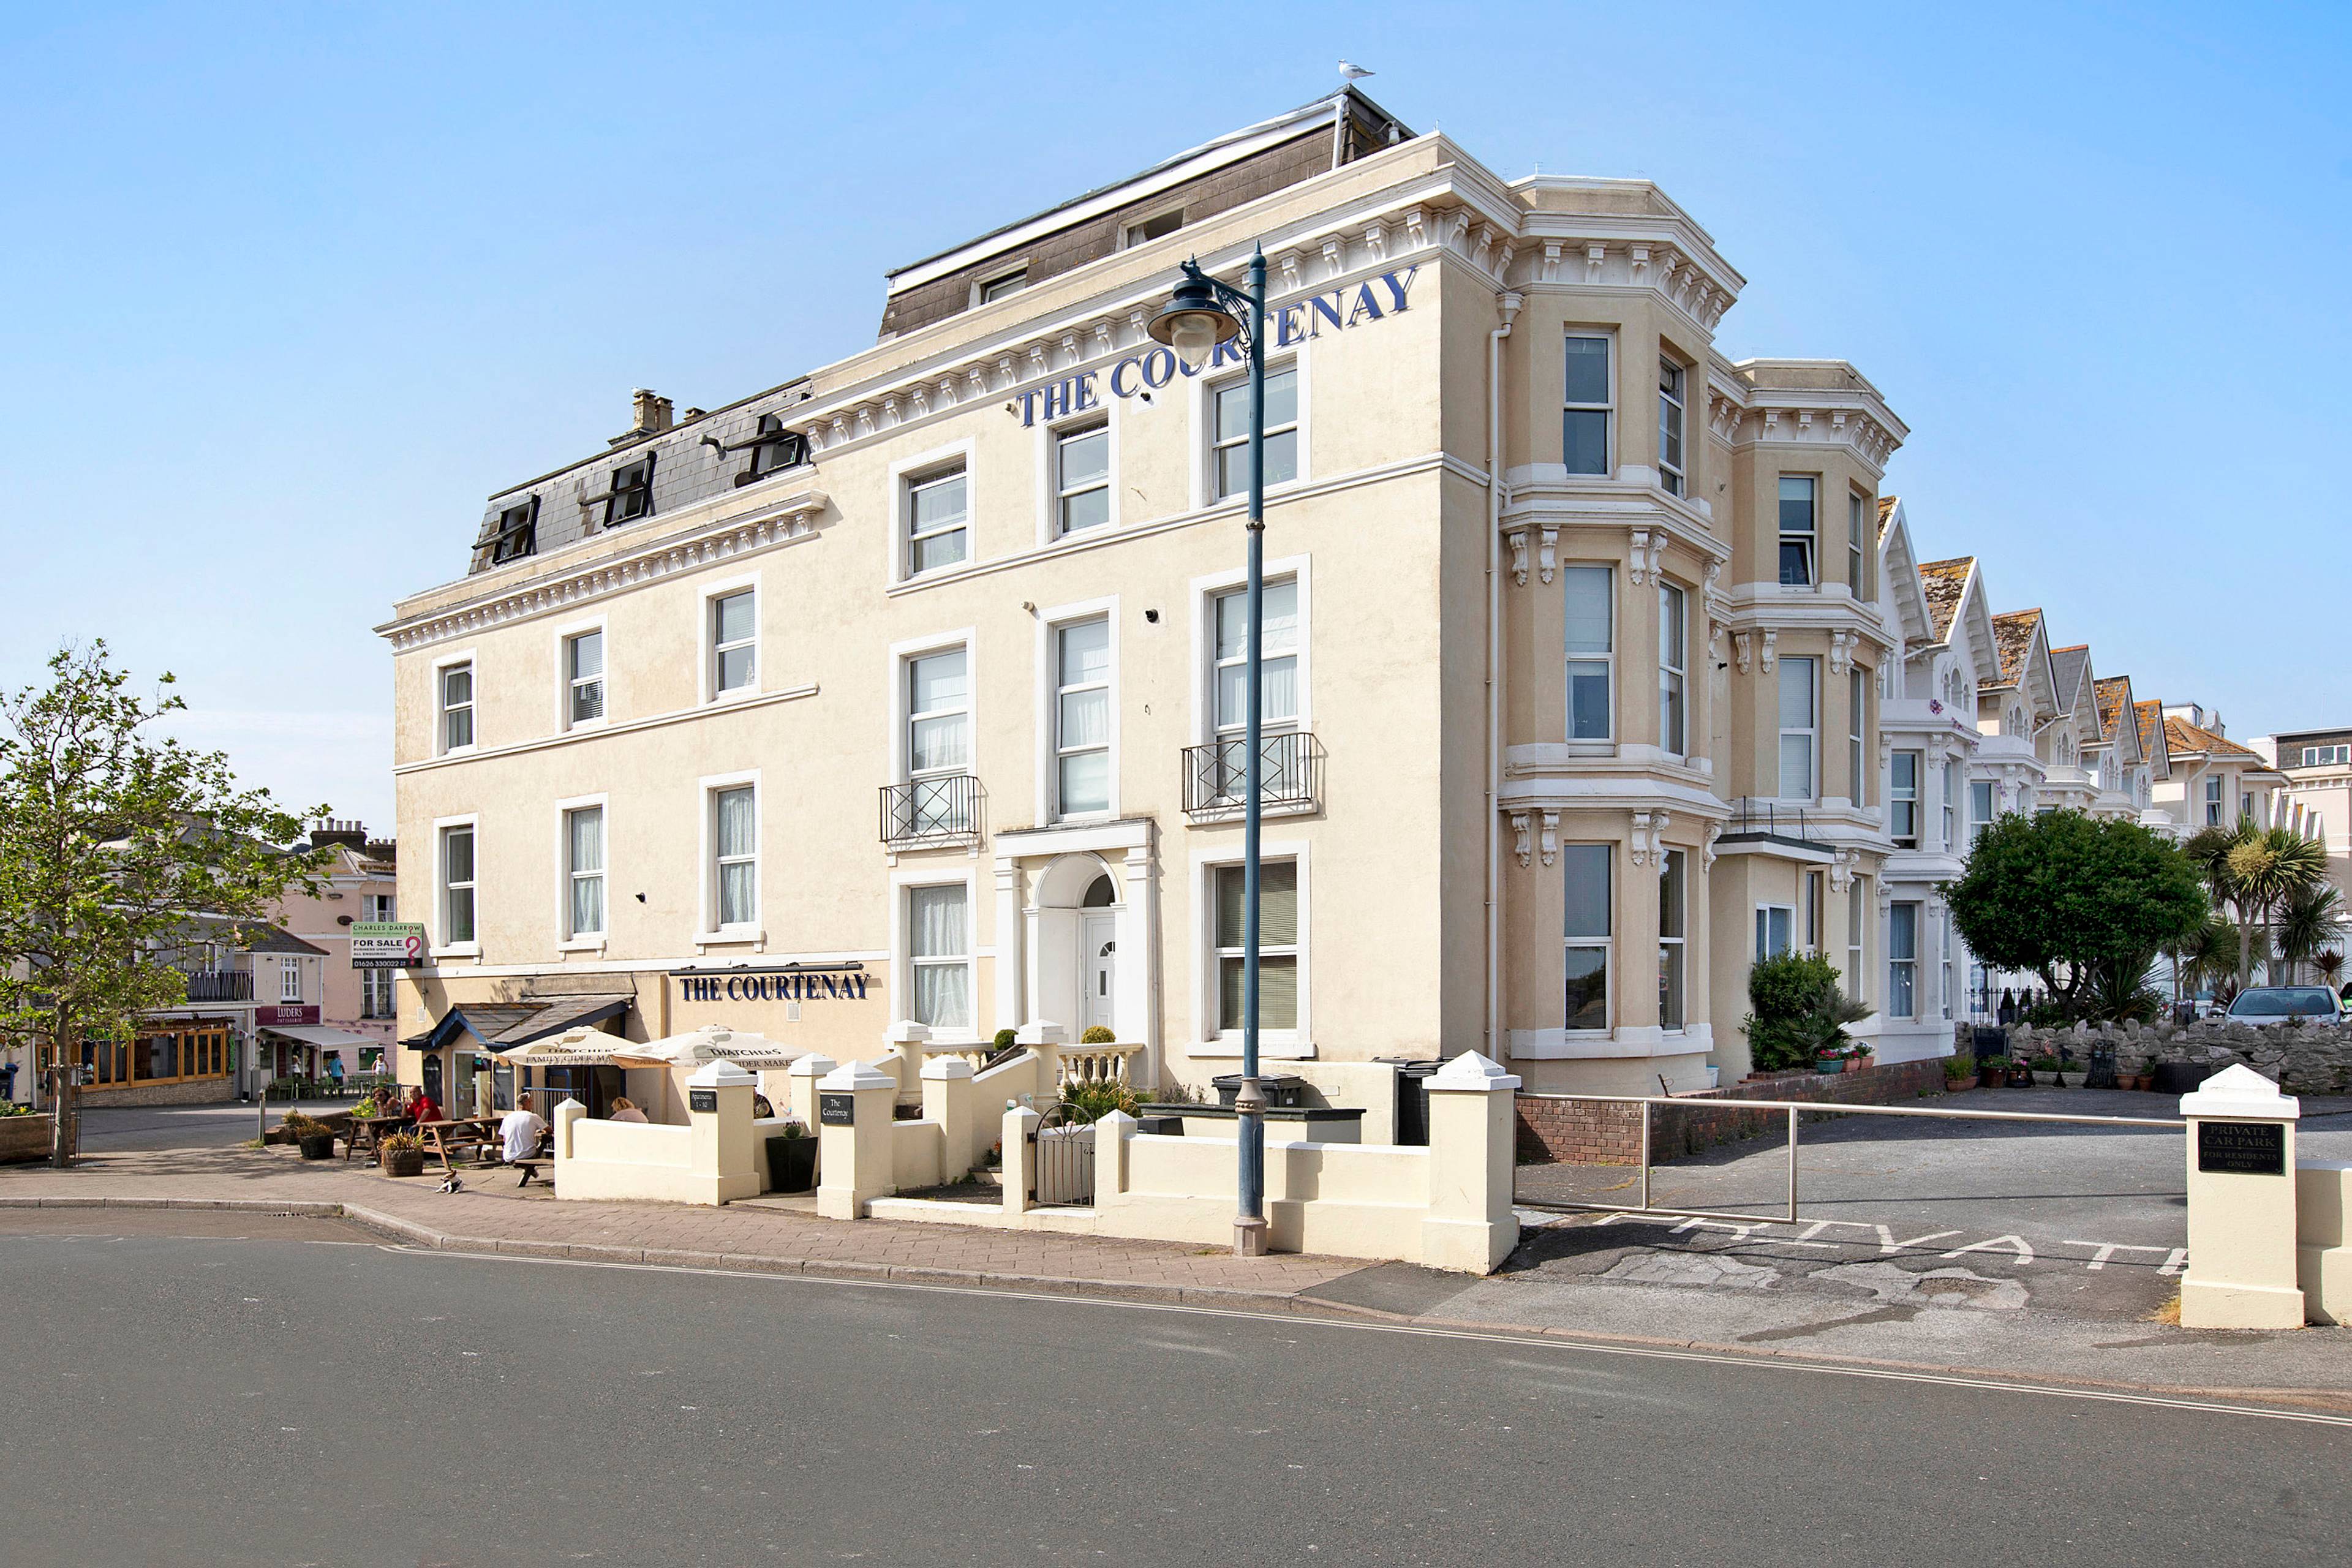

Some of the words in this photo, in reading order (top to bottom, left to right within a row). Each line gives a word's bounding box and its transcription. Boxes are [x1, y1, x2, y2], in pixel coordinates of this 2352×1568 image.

[1016, 370, 1099, 428] THE
[1110, 264, 1419, 398] CORENAY
[680, 978, 723, 1002] THE
[727, 973, 872, 1001] COURTENAY
[277, 1007, 303, 1017] LUDERS
[526, 1055, 562, 1063] FAMILY
[822, 1107, 848, 1120] Courtenay
[2210, 1125, 2269, 1136] PRIVATE
[2204, 1136, 2234, 1145] CAR
[2237, 1137, 2275, 1147] PARK
[2225, 1152, 2277, 1161] RESIDENTS
